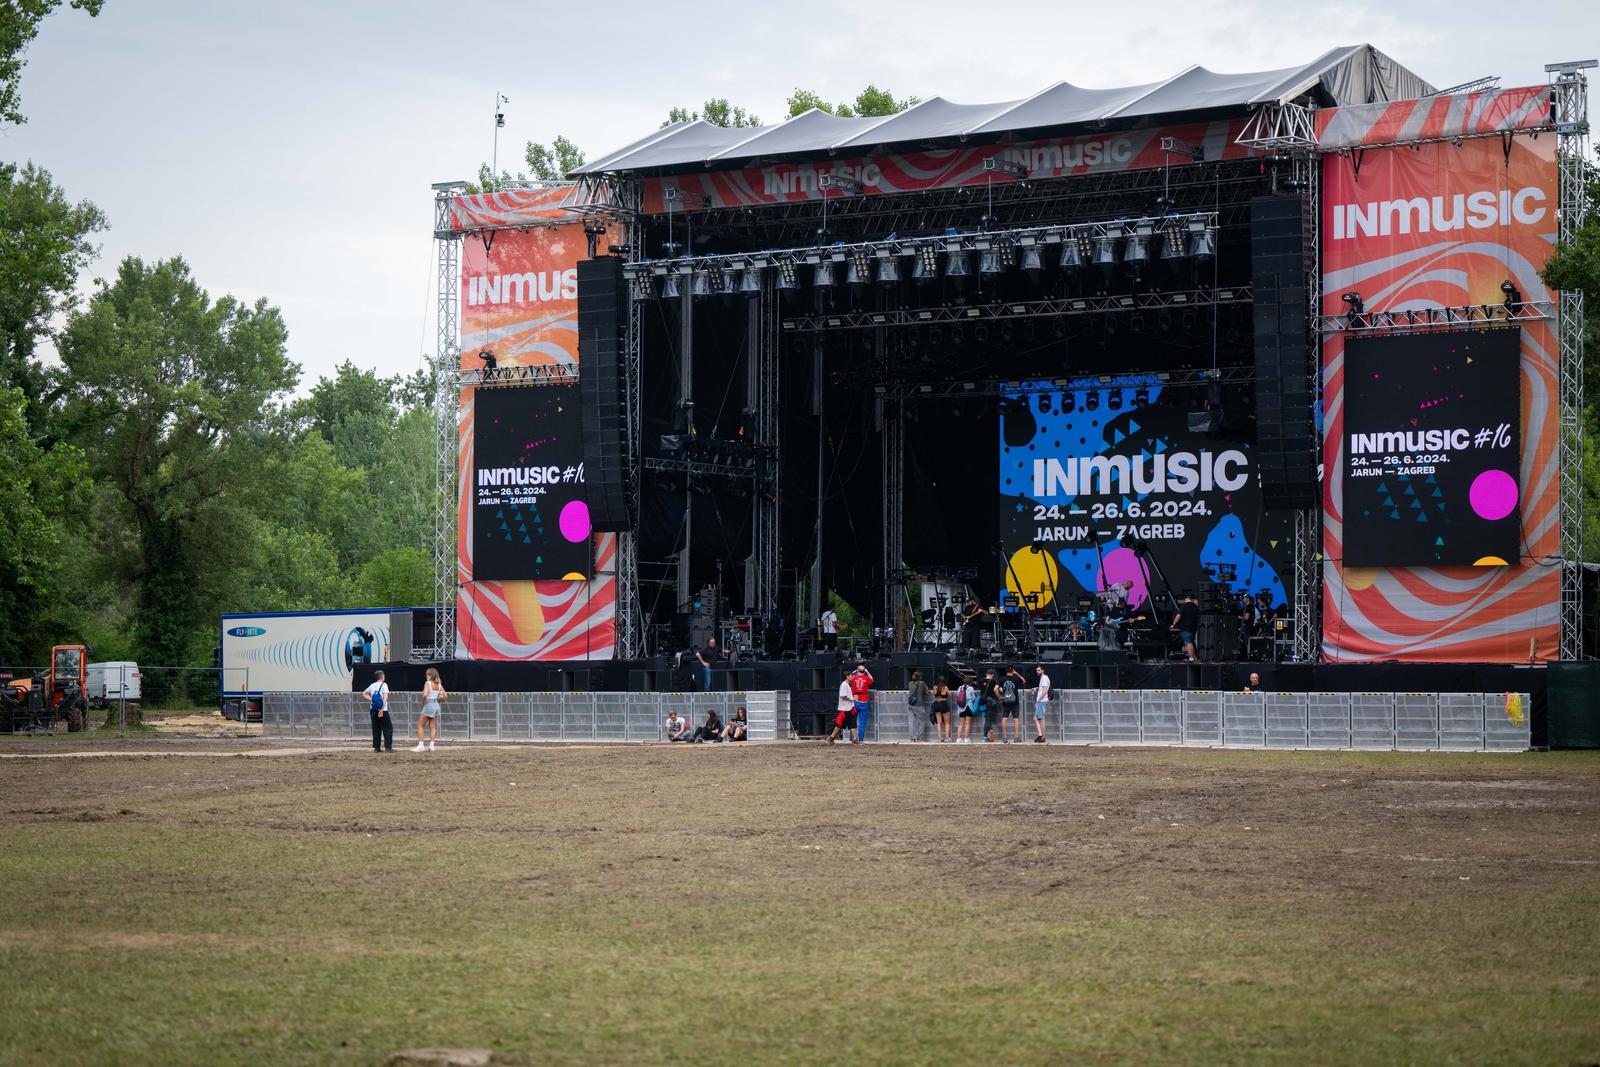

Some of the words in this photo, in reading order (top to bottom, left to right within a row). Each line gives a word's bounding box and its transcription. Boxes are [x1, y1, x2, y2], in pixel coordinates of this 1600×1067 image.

[1474, 423, 1512, 449] #16
[1416, 454, 1450, 463] 2024.
[1351, 468, 1383, 477] JARUN
[1397, 466, 1436, 475] ZAGREB
[523, 487, 547, 495] 2024.
[1033, 504, 1065, 521] 24.
[1150, 500, 1212, 517] 2024.
[1033, 526, 1089, 542] JARUN
[1116, 523, 1186, 540] ZAGREB
